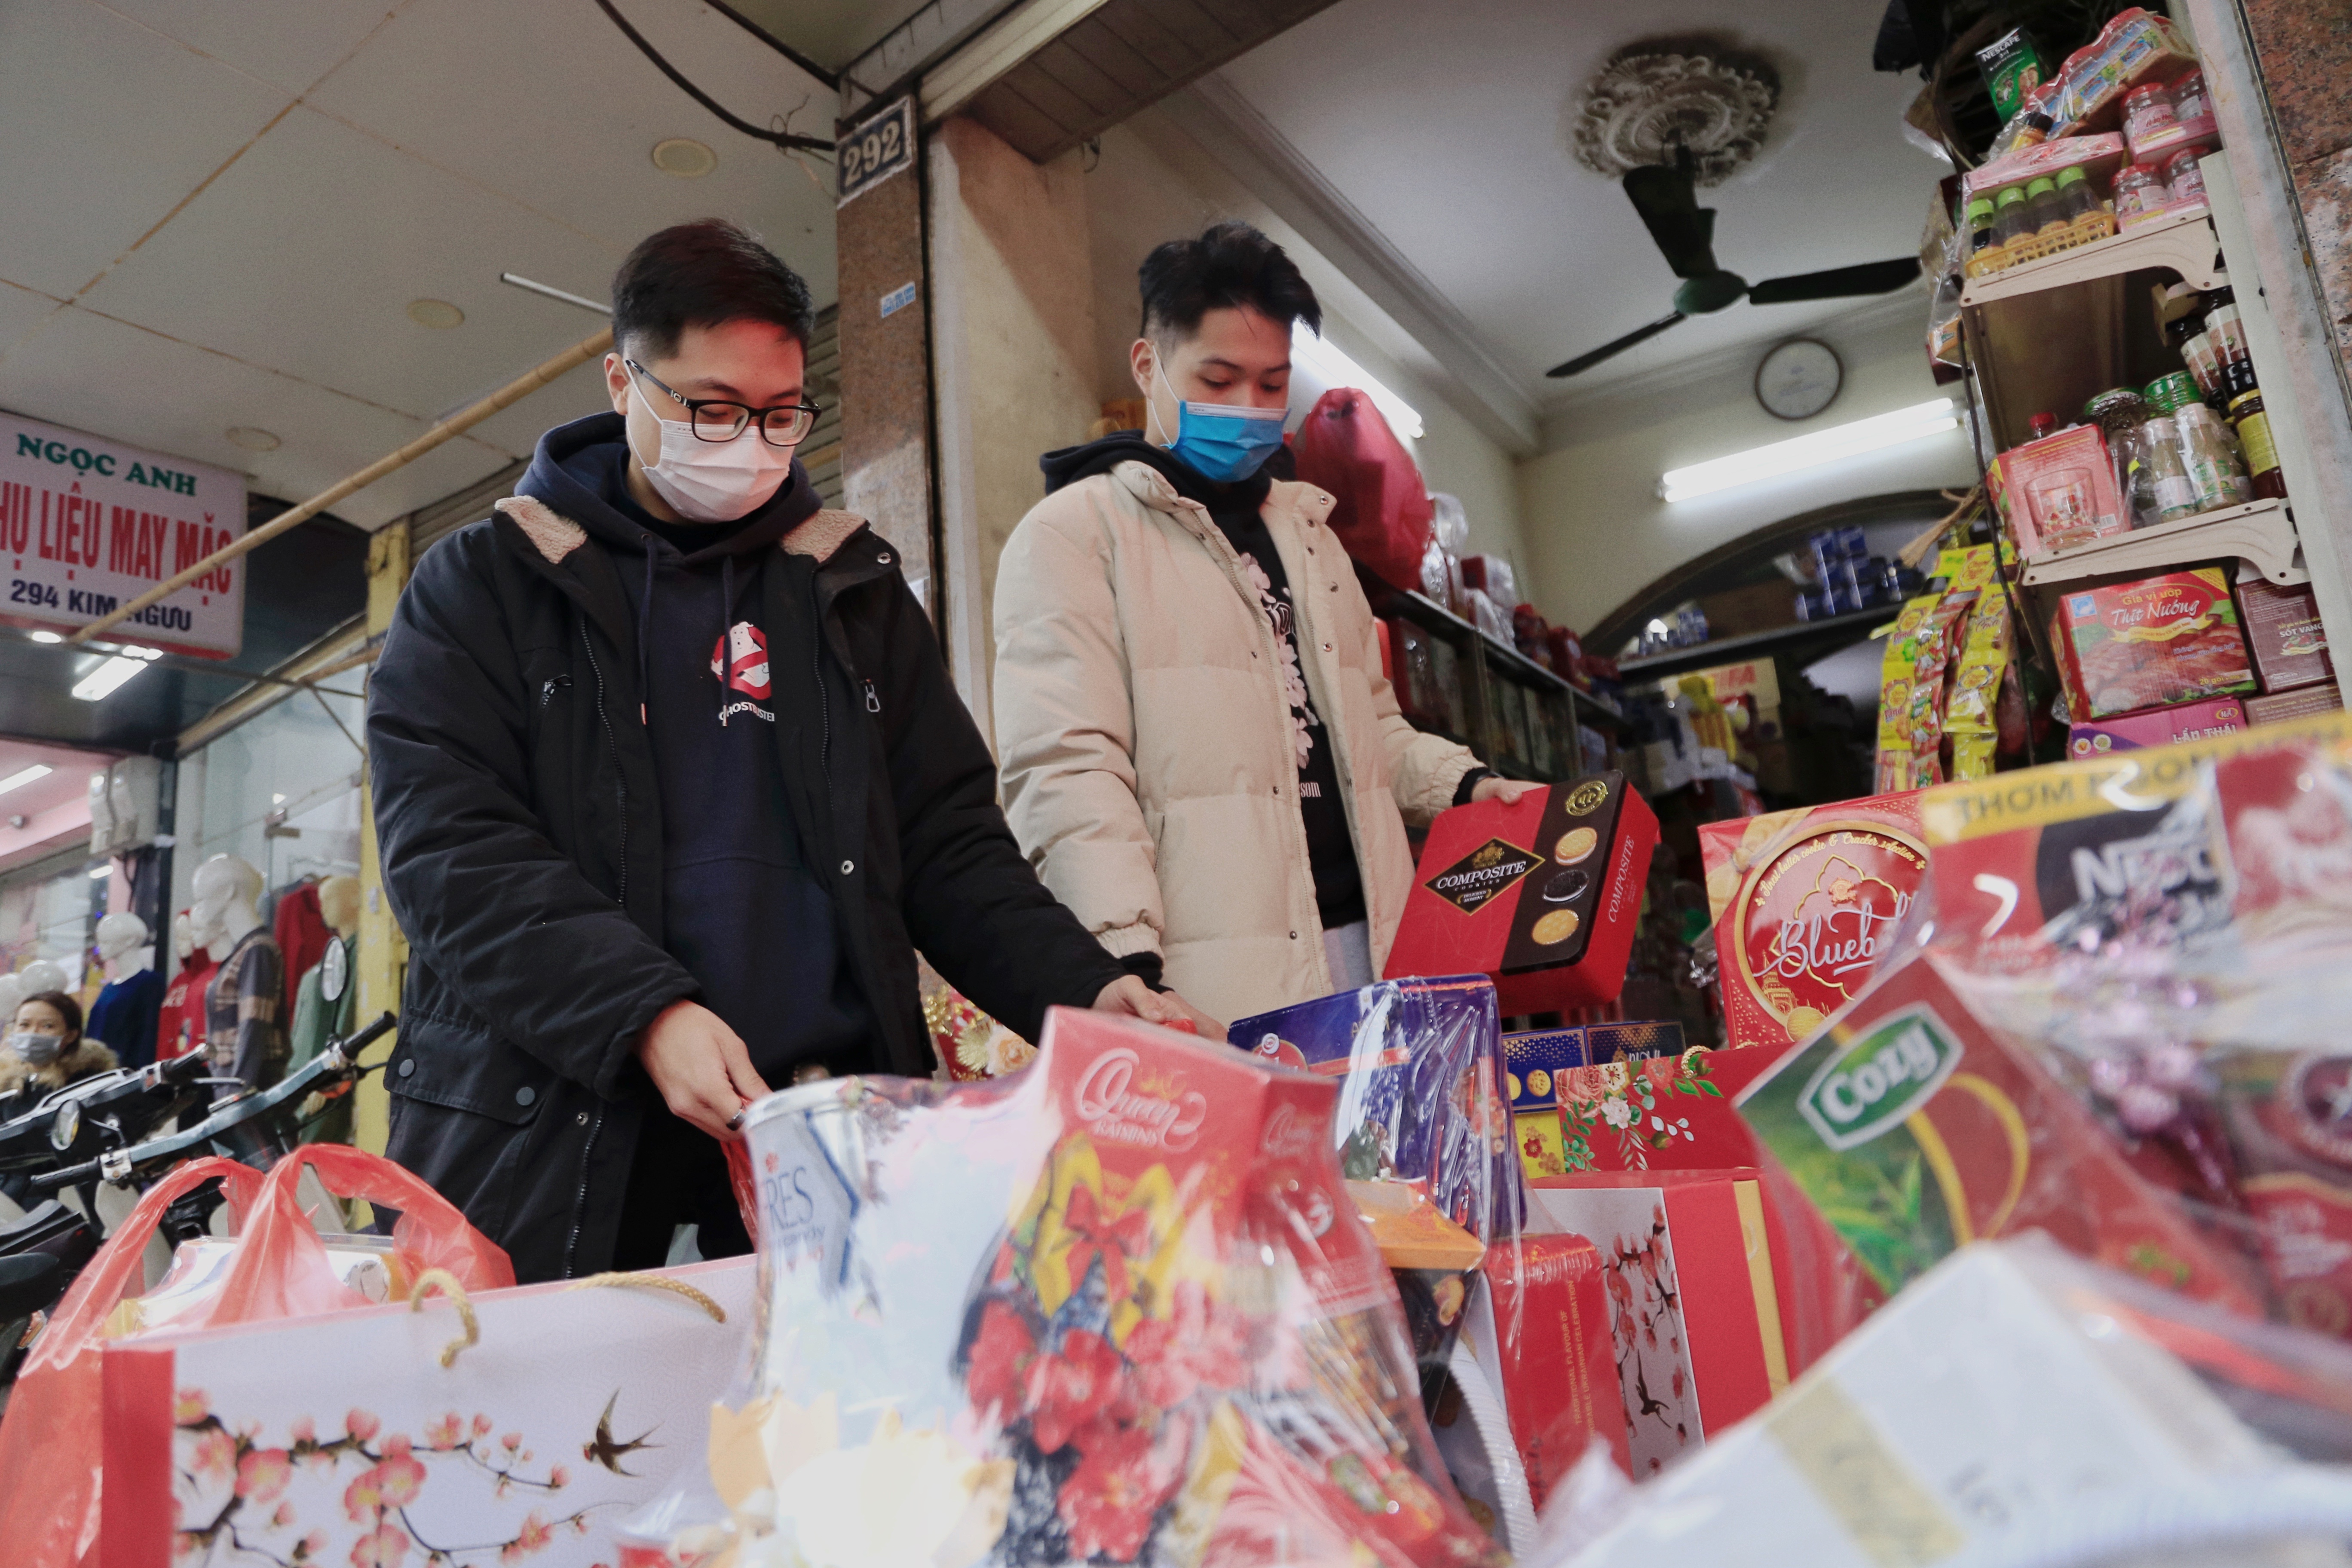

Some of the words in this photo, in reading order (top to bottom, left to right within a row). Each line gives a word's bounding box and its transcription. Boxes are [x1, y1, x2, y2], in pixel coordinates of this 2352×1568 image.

[843, 120, 901, 187] 292
[16, 433, 117, 476] NGỌC
[125, 461, 197, 496] ANH
[39, 481, 102, 581] LIỆU
[109, 505, 169, 581] MAY
[10, 579, 61, 609] 294
[68, 589, 117, 616] KIM
[2122, 595, 2143, 605] Gia
[1436, 861, 1527, 885] COMPOSITE
[1801, 839, 1826, 858] cookie
[1829, 833, 1839, 846] &
[1843, 831, 1879, 846] Cracker
[1878, 838, 1915, 862] selection
[1608, 835, 1635, 923] COMPOSITE
[1820, 1025, 1939, 1123] Cozy
[1560, 1310, 1568, 1321] OF
[1568, 1280, 1583, 1342] CELEBRATION
[1562, 1323, 1574, 1365] FLAVOUR
[1576, 1343, 1590, 1393] UKRAINIAN
[1569, 1366, 1583, 1425] TRADITIONAL
